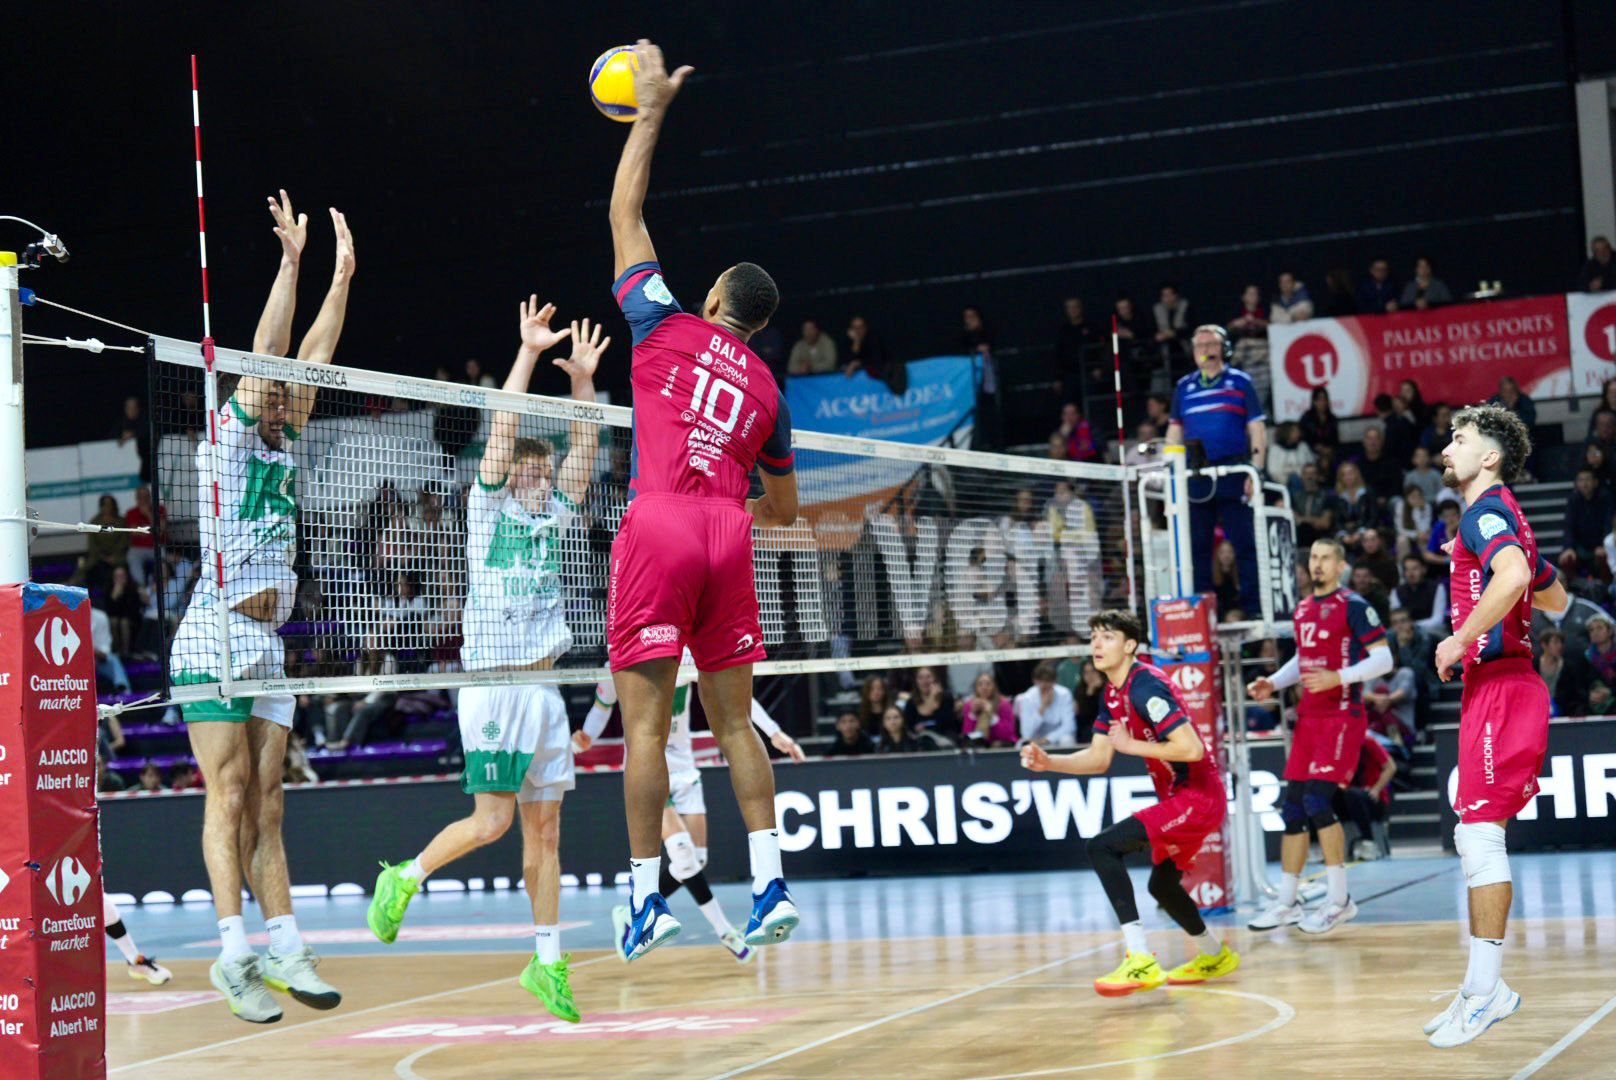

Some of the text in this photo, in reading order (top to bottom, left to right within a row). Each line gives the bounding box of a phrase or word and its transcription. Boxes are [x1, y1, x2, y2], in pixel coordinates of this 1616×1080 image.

[1383, 313, 1554, 347] PALAIS DES SPORTS
[709, 334, 747, 370] BALA
[1384, 336, 1558, 370] ET DES SPECTACLES
[305, 366, 347, 387] CORSICA
[714, 358, 749, 386] FORMA
[459, 388, 487, 406] CORSE
[690, 365, 745, 434] 10
[573, 405, 605, 421] CORSICA
[1469, 568, 1481, 601] CLUB
[609, 577, 618, 630] LUCCIONI
[1300, 622, 1317, 647] 12
[30, 674, 89, 692] Carrefour
[39, 694, 82, 710] market
[39, 749, 88, 766] AJACCIO
[1483, 737, 1495, 785] LUCCIONI
[36, 773, 91, 791] Albert 1er
[484, 762, 498, 781] 11
[774, 770, 1287, 852] CHRIS'WER
[42, 913, 96, 934] Carrefour
[50, 933, 91, 952] market
[50, 991, 96, 1013] AJACCIO
[50, 1017, 98, 1038] Albert 1er
